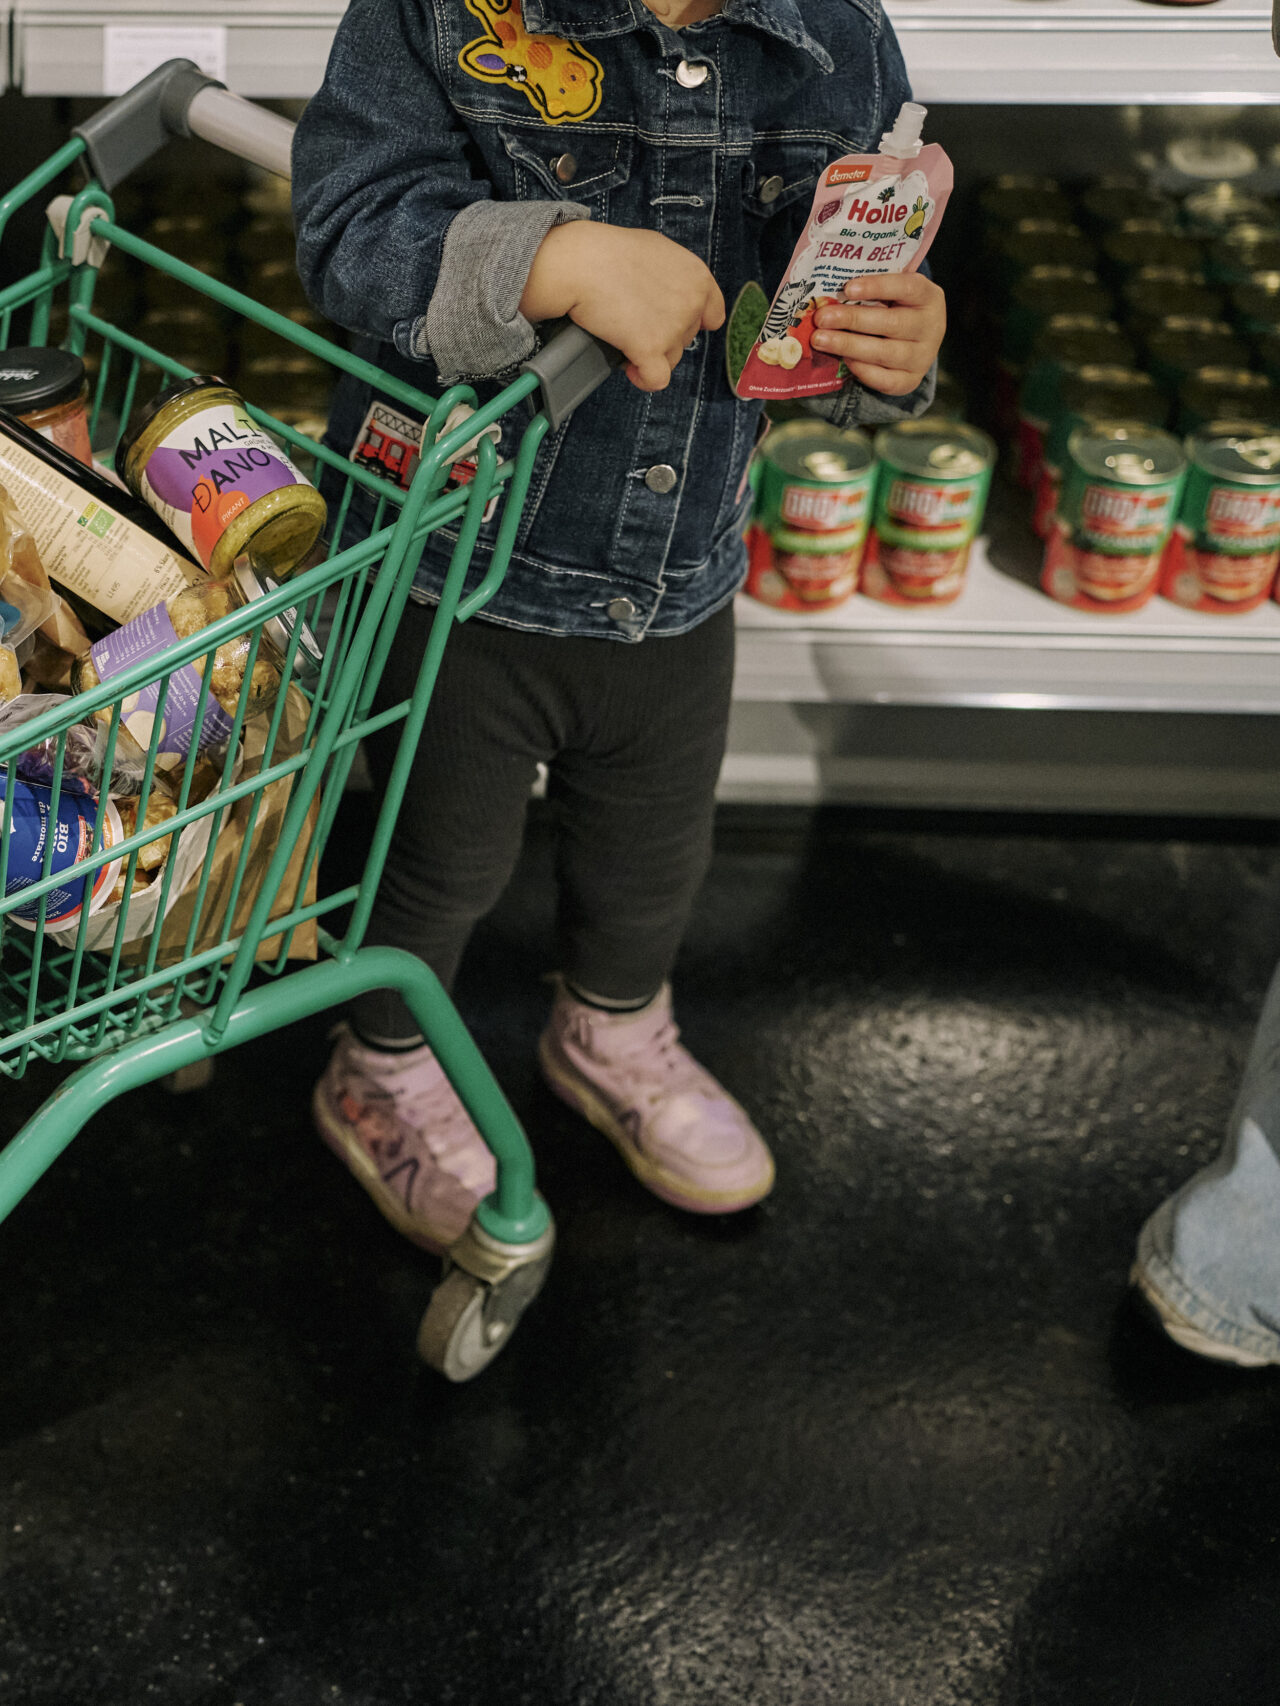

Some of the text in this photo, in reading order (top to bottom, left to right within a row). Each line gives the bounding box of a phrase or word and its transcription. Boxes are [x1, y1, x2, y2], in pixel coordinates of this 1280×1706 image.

[829, 168, 866, 182] demeter
[847, 198, 908, 225] Holle
[839, 228, 898, 242] Bio Organic
[866, 241, 906, 262] BEET
[178, 419, 262, 470] MALI
[221, 497, 245, 523] PIKANT
[30, 801, 48, 862] da montare
[54, 822, 70, 853] BIO
